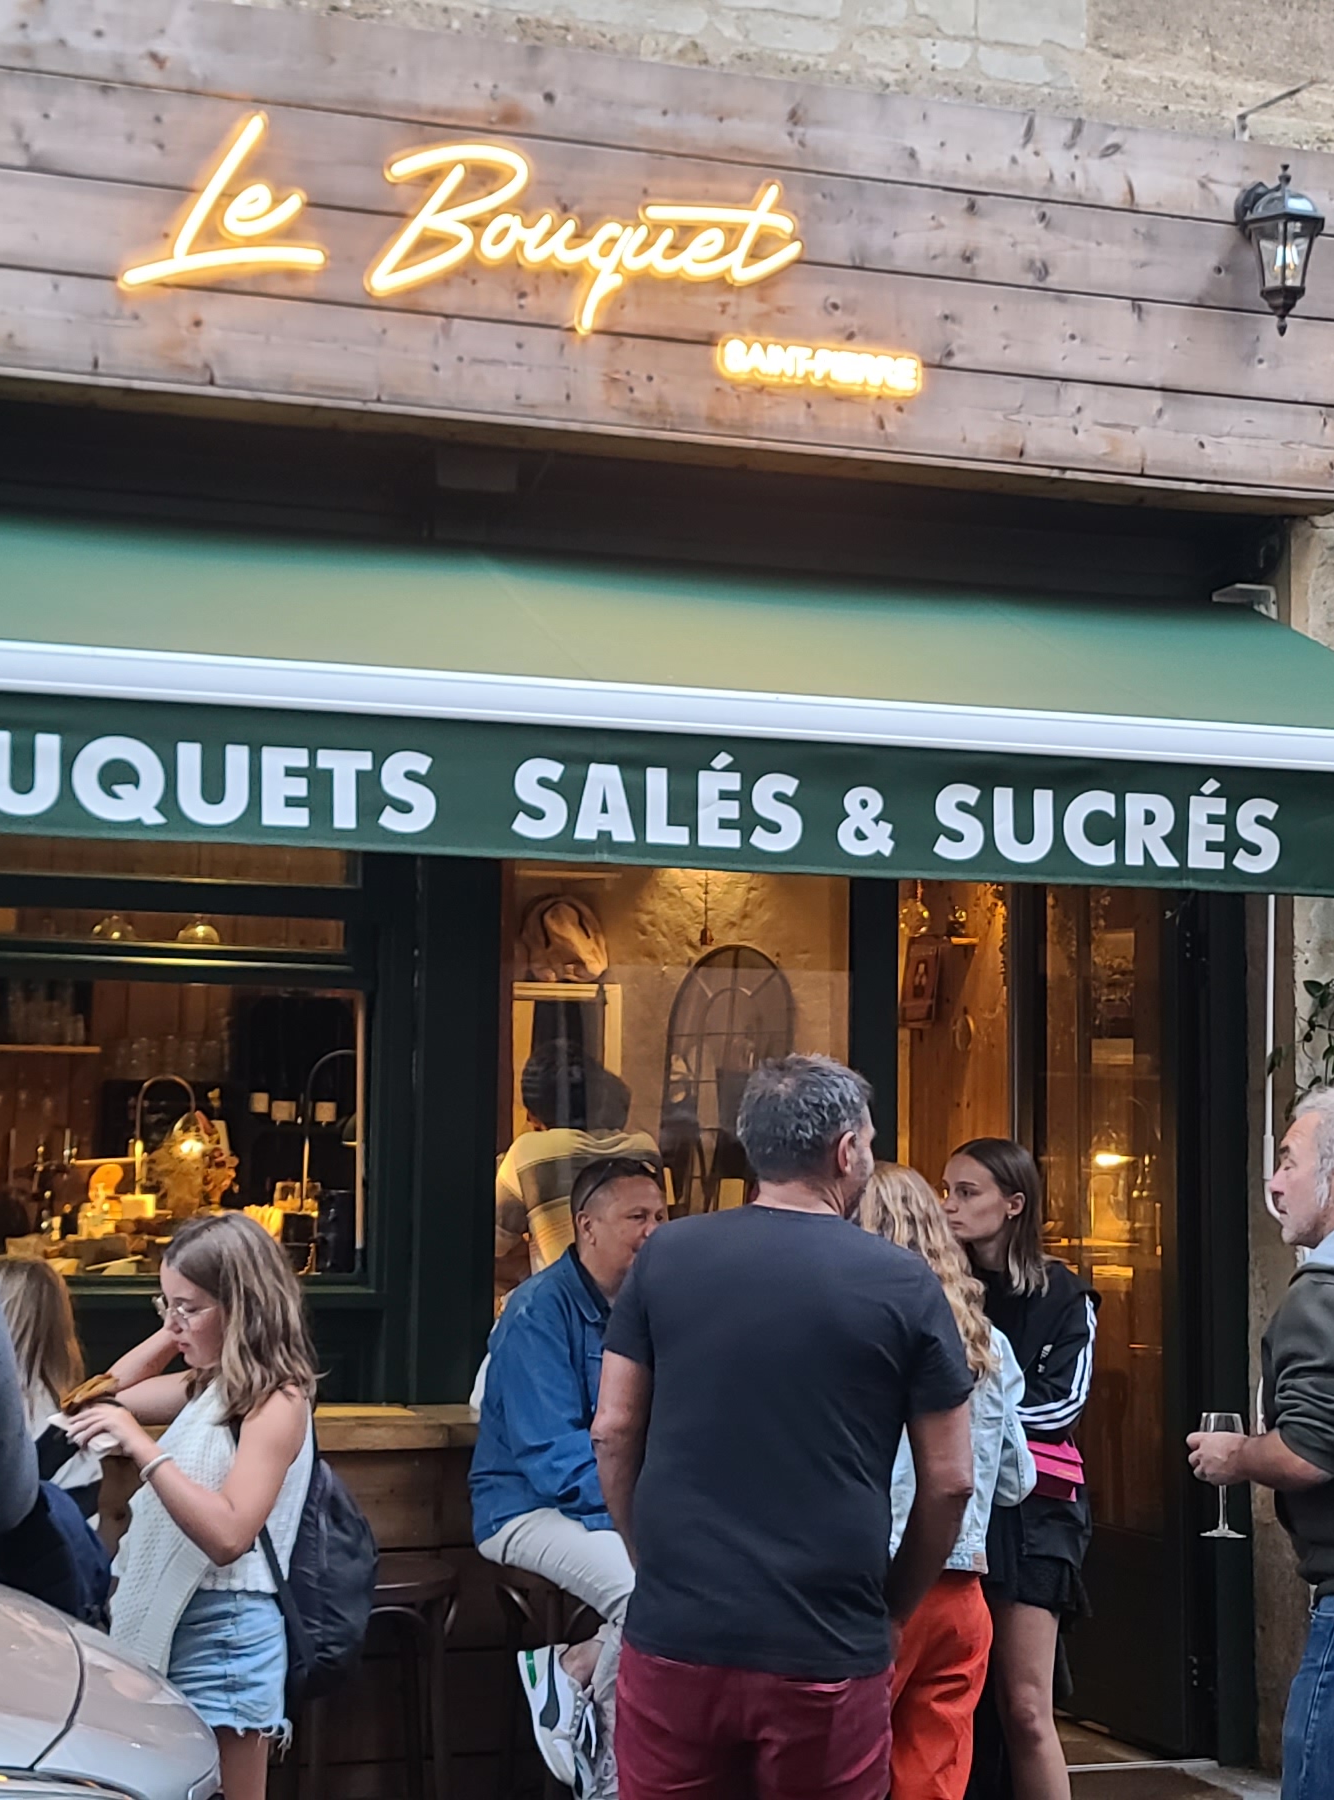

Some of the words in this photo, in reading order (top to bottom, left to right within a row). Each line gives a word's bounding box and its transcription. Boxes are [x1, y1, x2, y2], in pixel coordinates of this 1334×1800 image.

[119, 111, 328, 289] Le
[366, 143, 804, 334] Bouquet
[511, 751, 802, 853] SALÉS
[837, 786, 895, 857] &
[933, 778, 1281, 874] SUCRÉS
